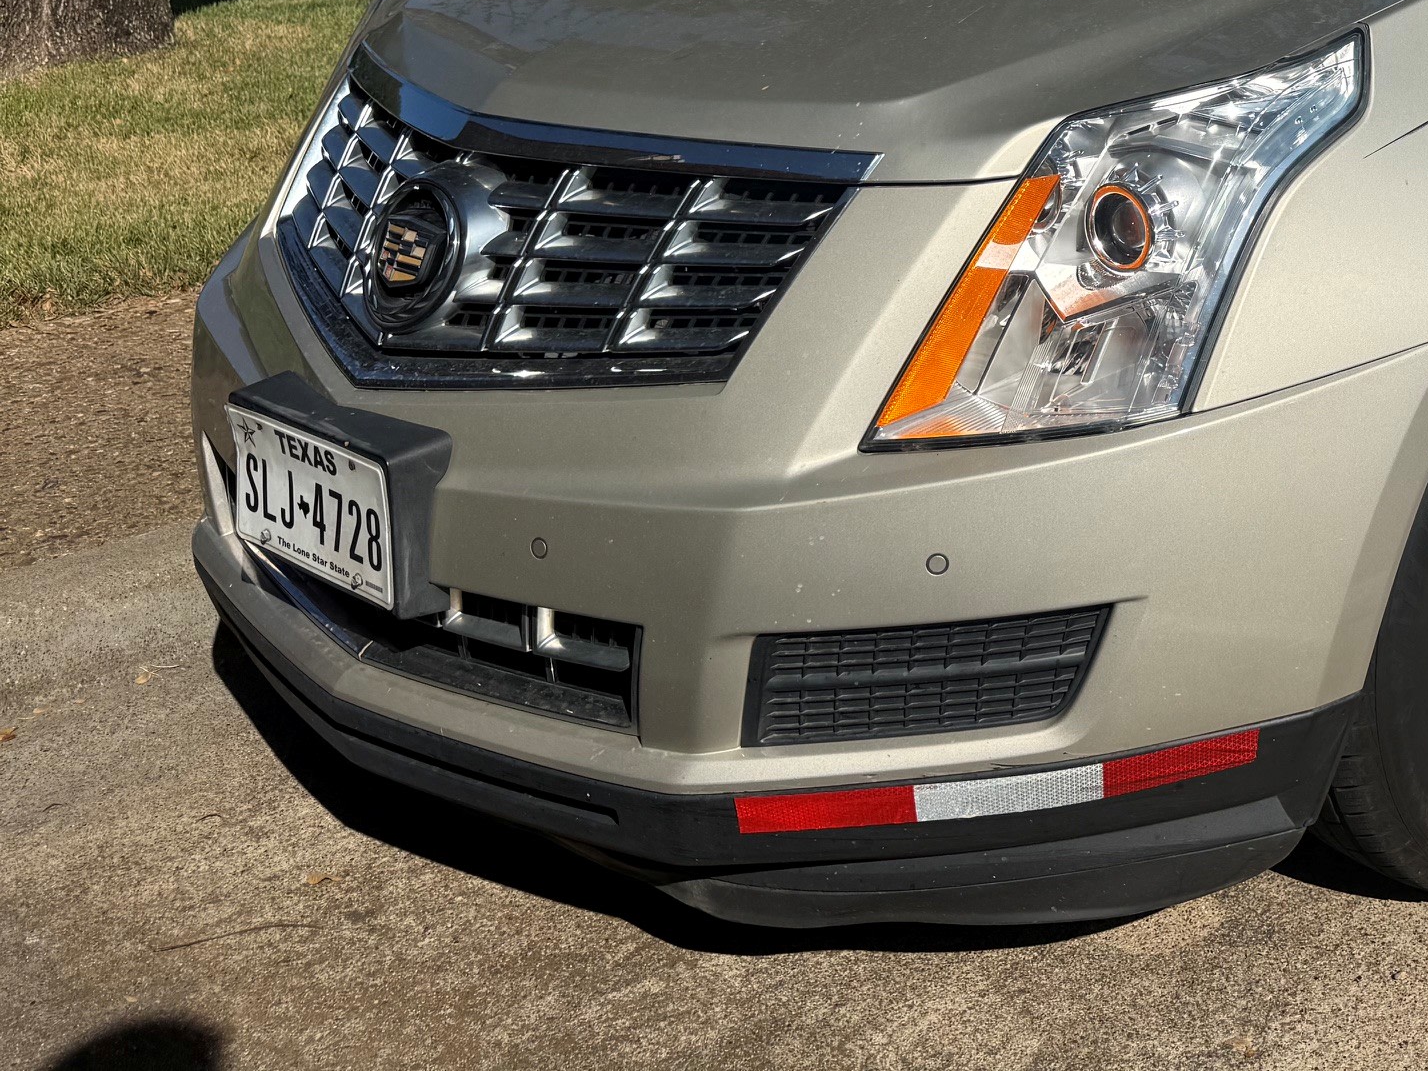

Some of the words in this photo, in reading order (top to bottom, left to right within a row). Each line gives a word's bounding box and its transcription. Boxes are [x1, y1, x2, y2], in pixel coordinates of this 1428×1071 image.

[274, 429, 337, 476] TEXAS
[277, 536, 291, 549] The
[292, 543, 310, 558] Lone
[312, 553, 328, 568] Star
[329, 561, 350, 578] State
